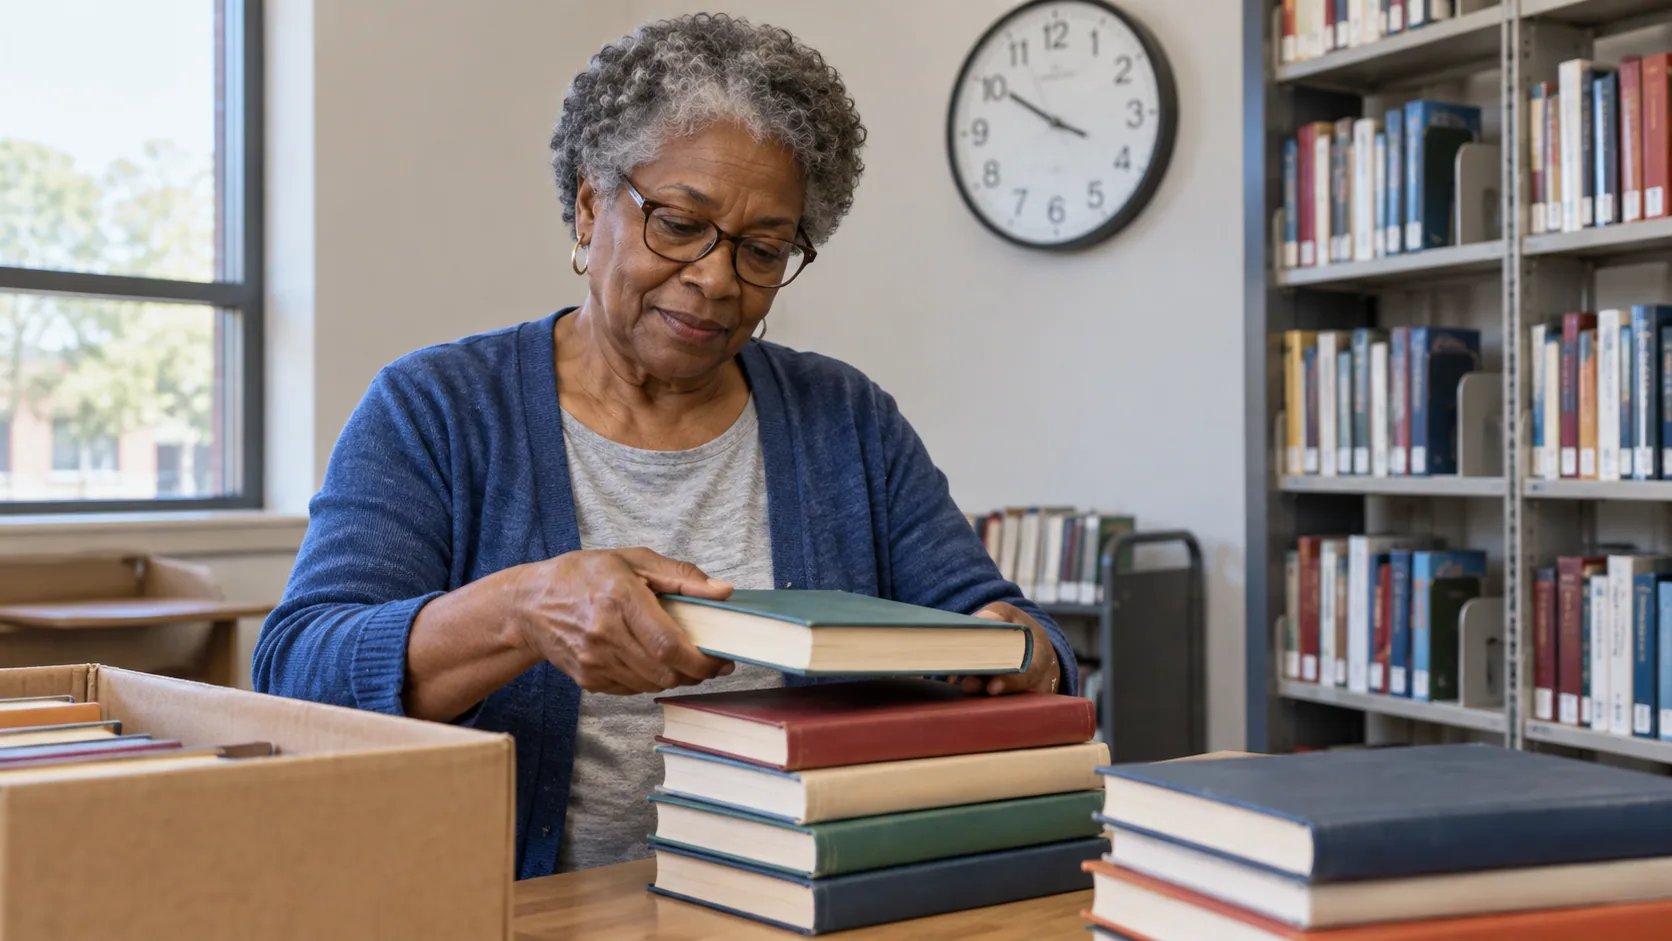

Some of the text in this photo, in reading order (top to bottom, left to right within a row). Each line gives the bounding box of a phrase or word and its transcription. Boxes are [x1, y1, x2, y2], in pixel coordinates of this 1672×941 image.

[1044, 20, 1069, 50] 12
[1090, 28, 1099, 57] 1
[1009, 38, 1028, 67] 11
[1113, 55, 1132, 85] 2
[982, 74, 1008, 103] 10
[1126, 98, 1144, 129] 3
[971, 118, 989, 147] 9
[1113, 145, 1131, 171] 4
[983, 159, 1000, 188] 8
[1012, 188, 1028, 216] 7
[1088, 180, 1104, 210] 5
[1048, 196, 1065, 225] 6
